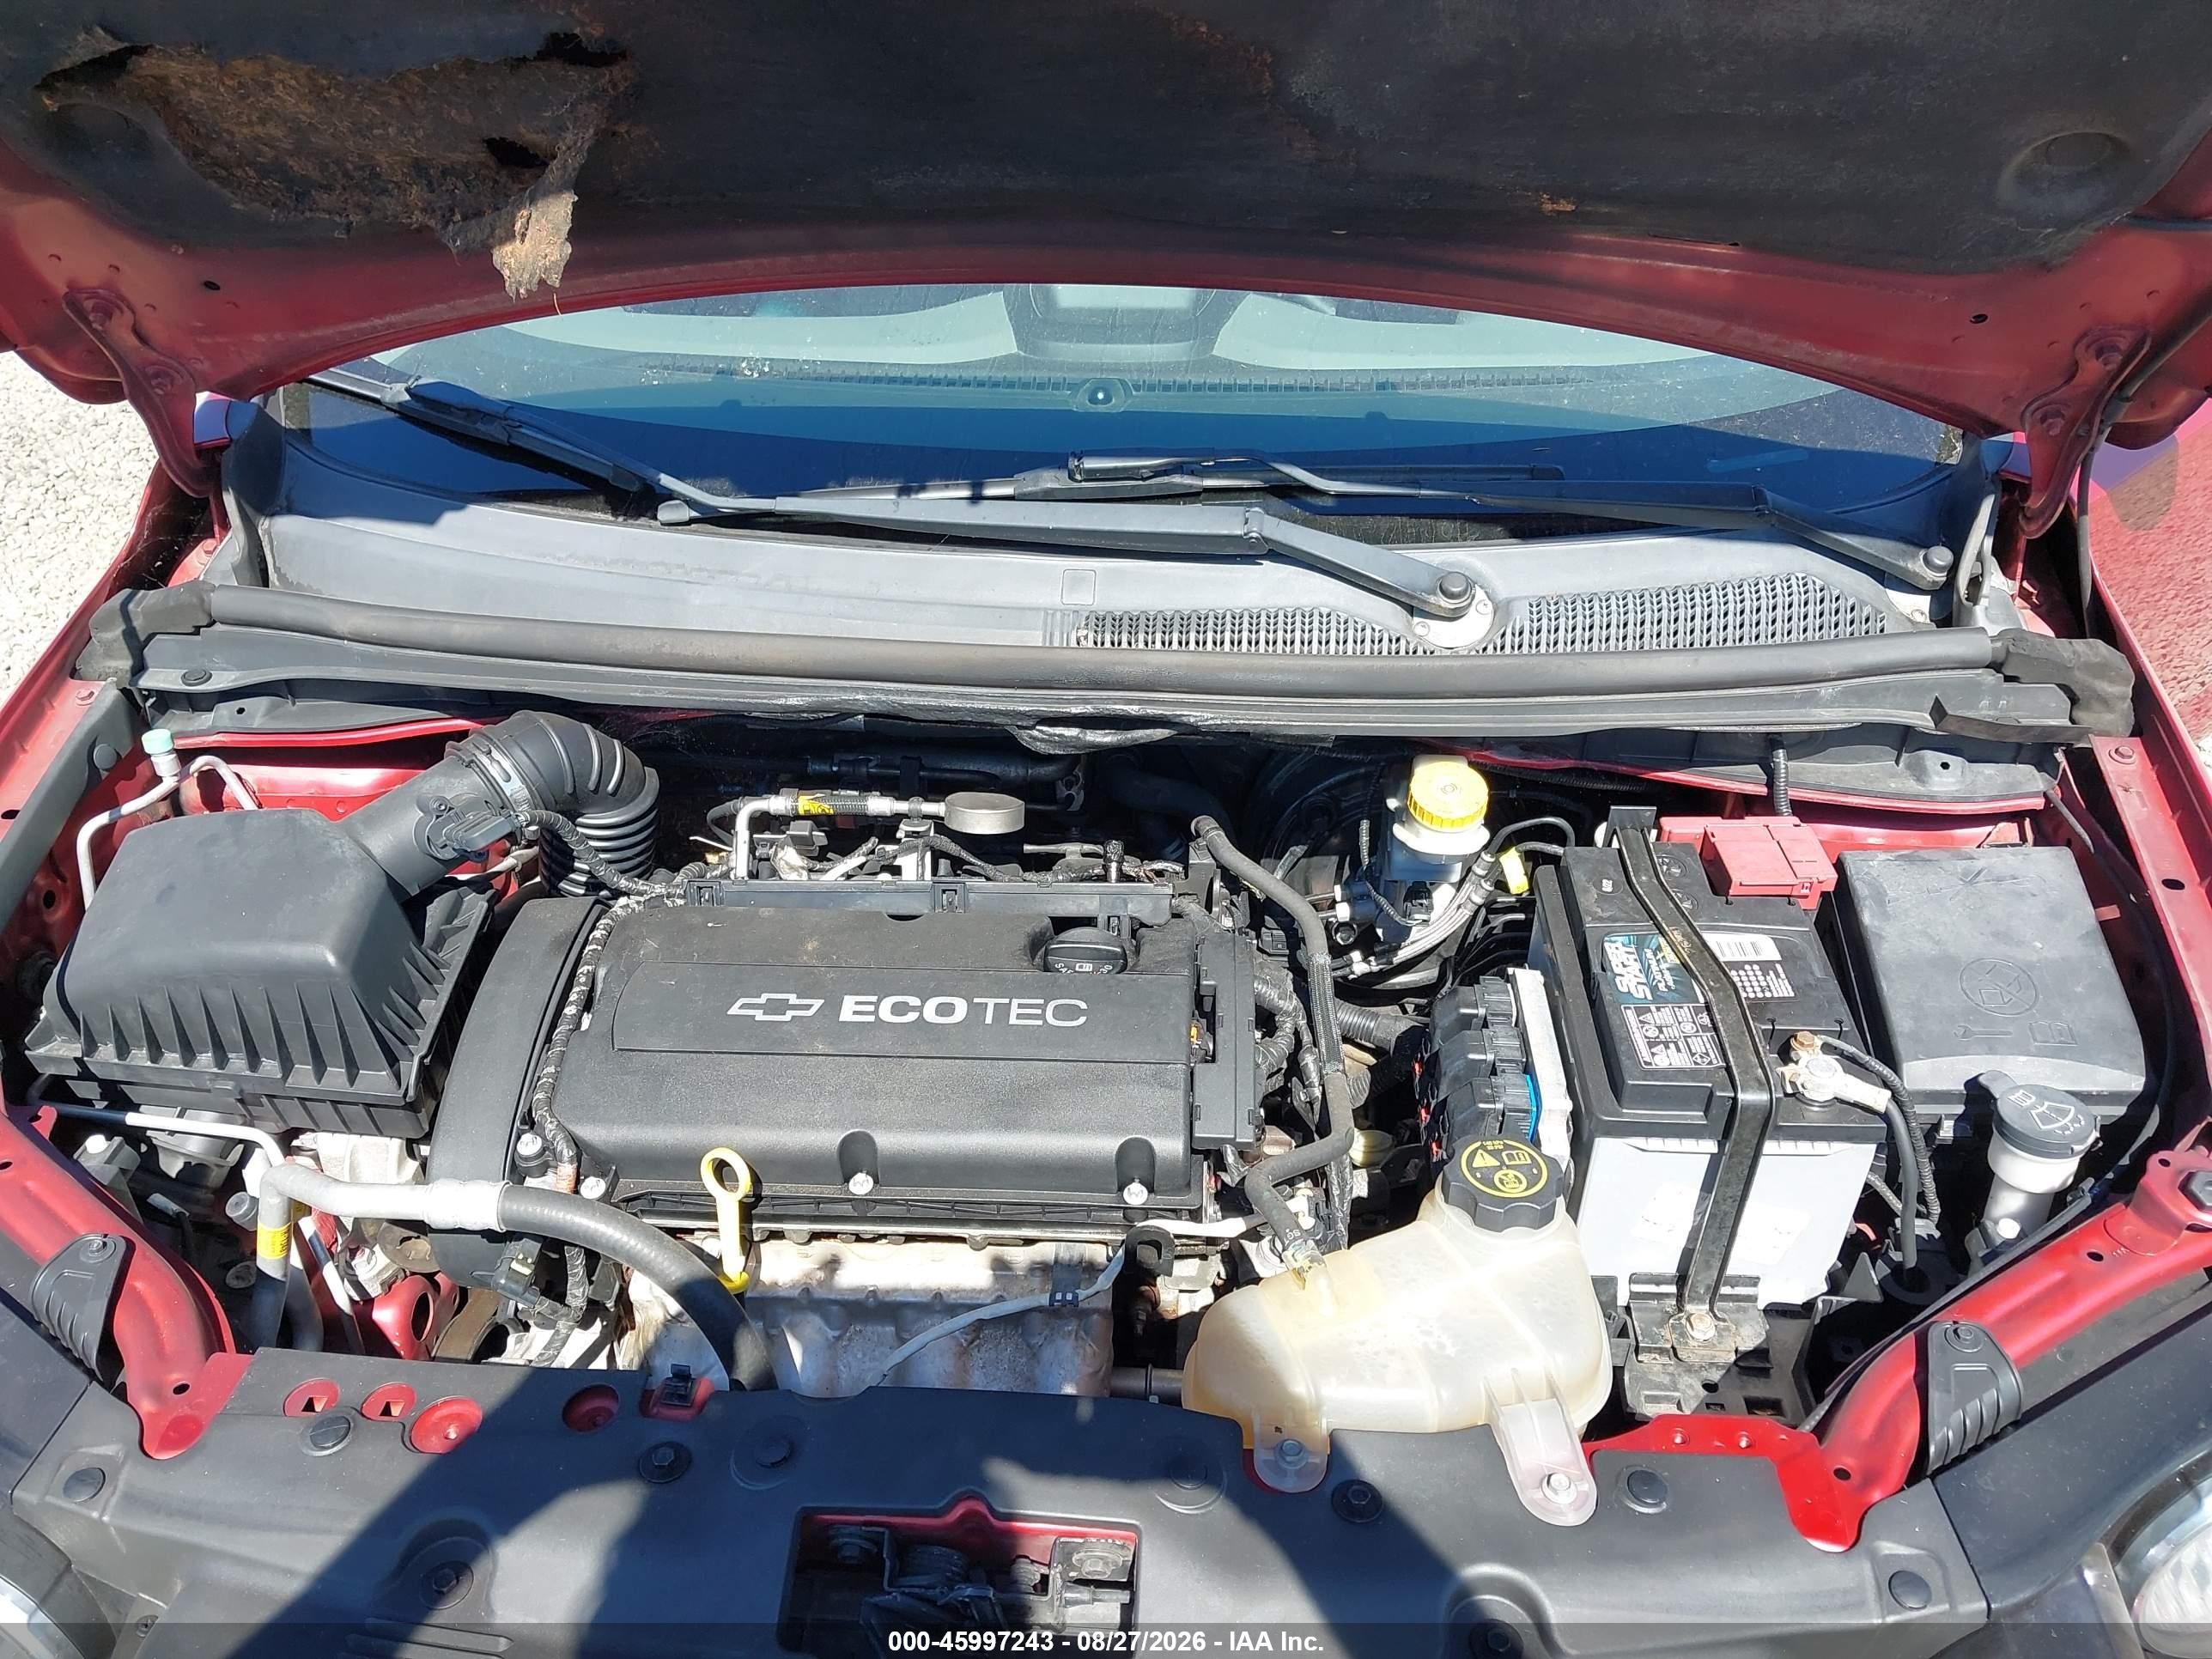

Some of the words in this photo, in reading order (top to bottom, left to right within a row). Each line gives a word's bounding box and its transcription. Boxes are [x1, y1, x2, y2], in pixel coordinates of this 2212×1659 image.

[1603, 940, 1633, 994] SUPER
[1620, 945, 1654, 1001] START
[838, 994, 1088, 1027] ECOTEC
